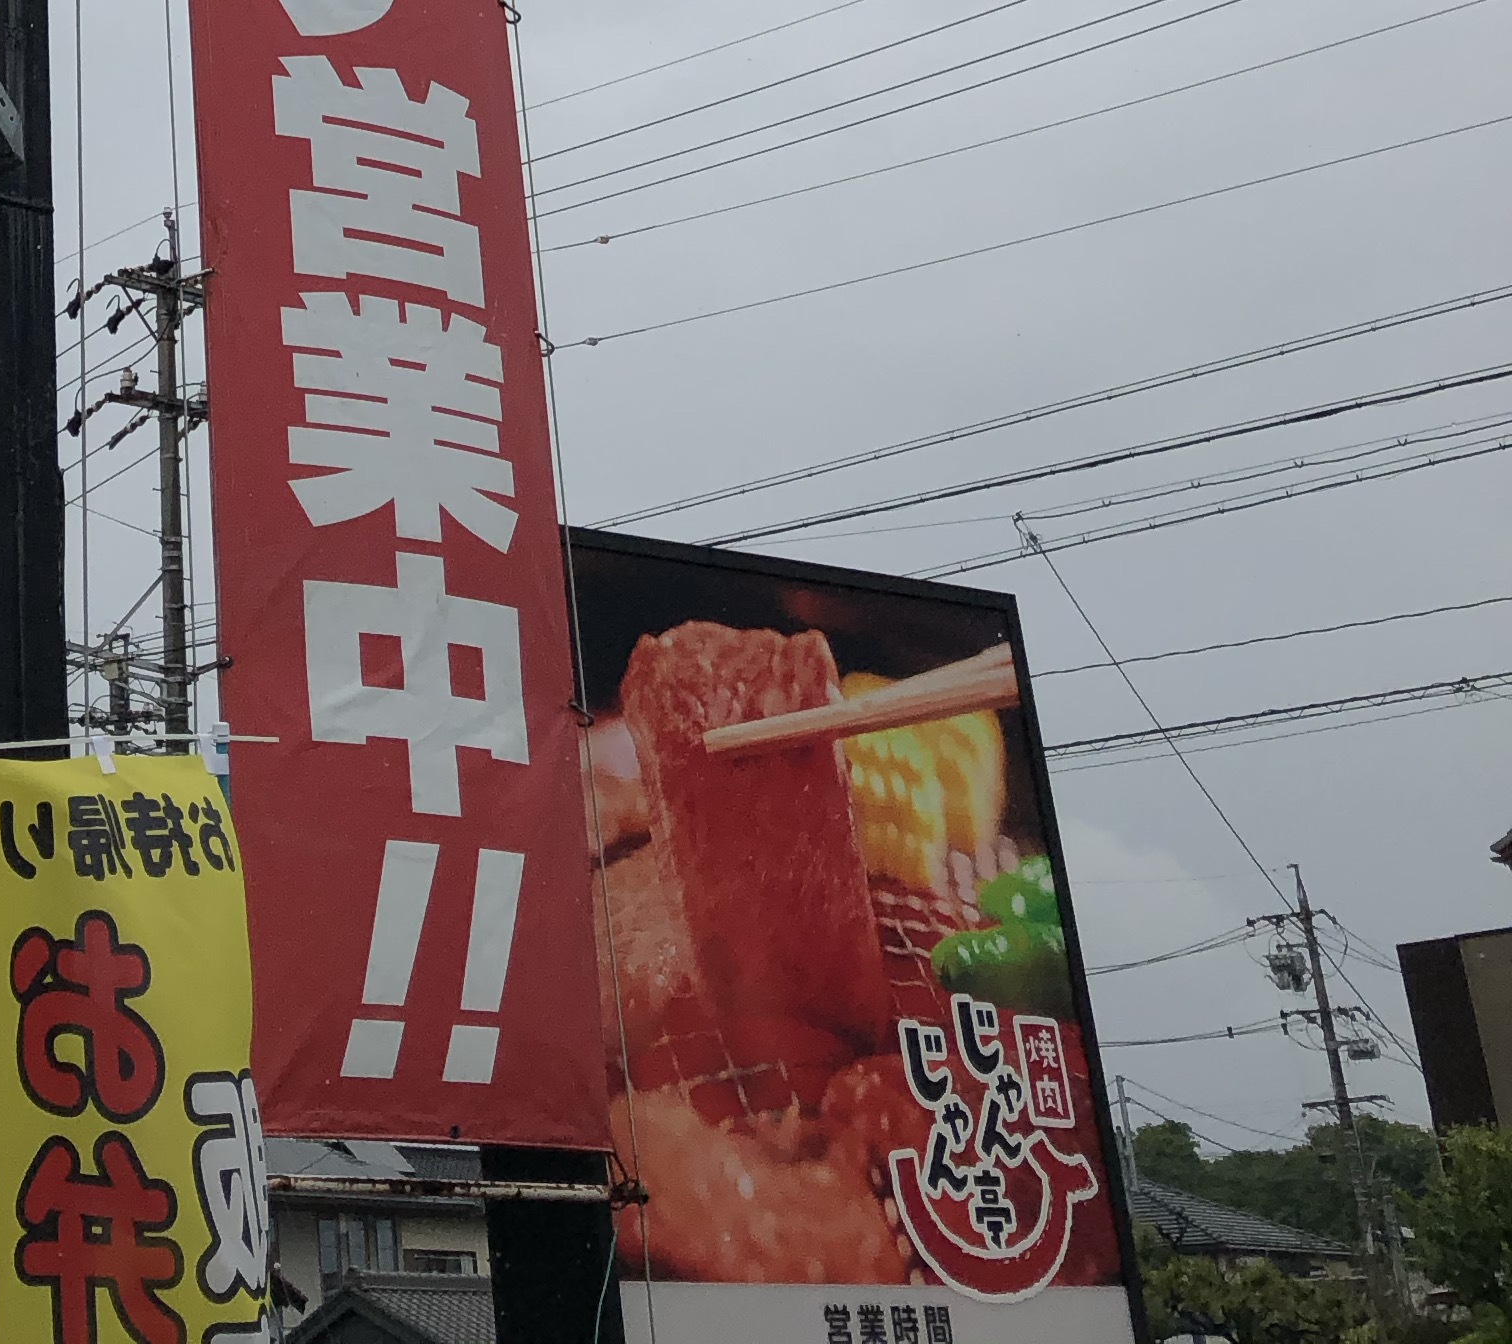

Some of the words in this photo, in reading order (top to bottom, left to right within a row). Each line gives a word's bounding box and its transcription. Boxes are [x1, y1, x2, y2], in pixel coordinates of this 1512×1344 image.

[1025, 1028, 1065, 1116] 焼肉
[822, 1302, 954, 1344] 営業時間
